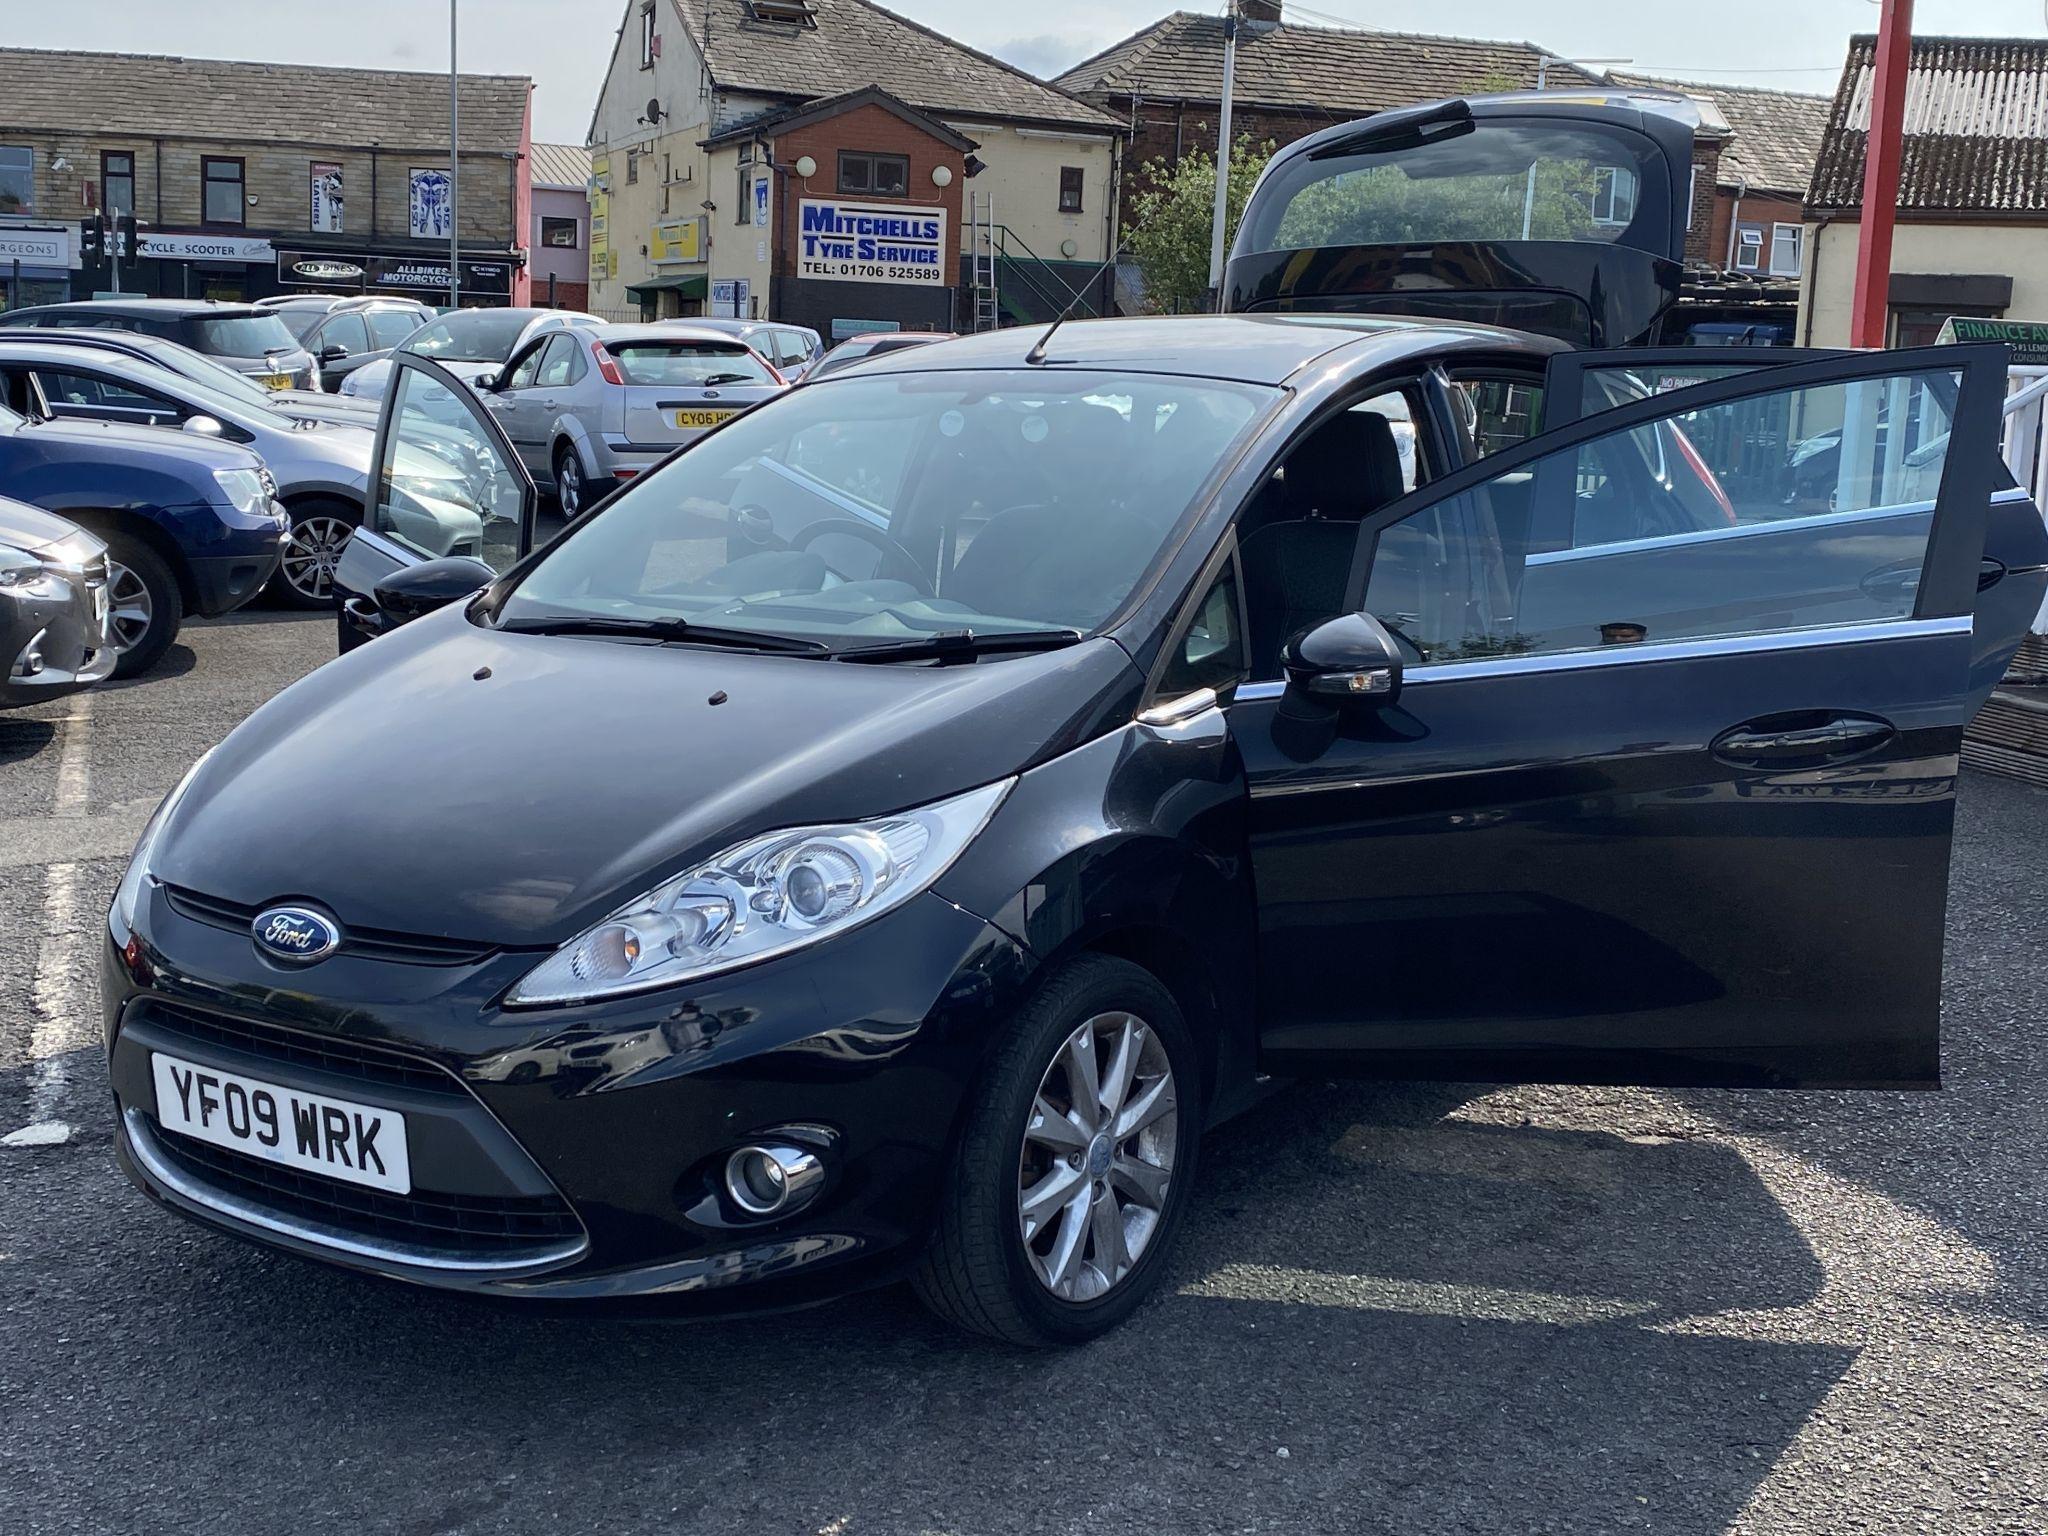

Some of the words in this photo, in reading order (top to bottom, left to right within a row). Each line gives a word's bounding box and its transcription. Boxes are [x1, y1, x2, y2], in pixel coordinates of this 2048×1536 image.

[803, 206, 939, 240] MITCHELLS
[185, 244, 235, 256] SCOOTER
[803, 235, 854, 259] TYRE
[858, 238, 938, 265] SERVICE
[300, 264, 317, 272] ALL
[322, 263, 355, 272] BIKES
[397, 265, 450, 277] ALLBIKES
[803, 261, 836, 275] TEL:
[840, 264, 884, 277] 01706
[888, 267, 940, 280] 525589
[1955, 321, 2029, 340] FINANCE
[681, 413, 713, 425] CY06
[264, 913, 315, 949] Ford
[170, 1065, 280, 1147] YF09
[290, 1097, 386, 1176] WRK
